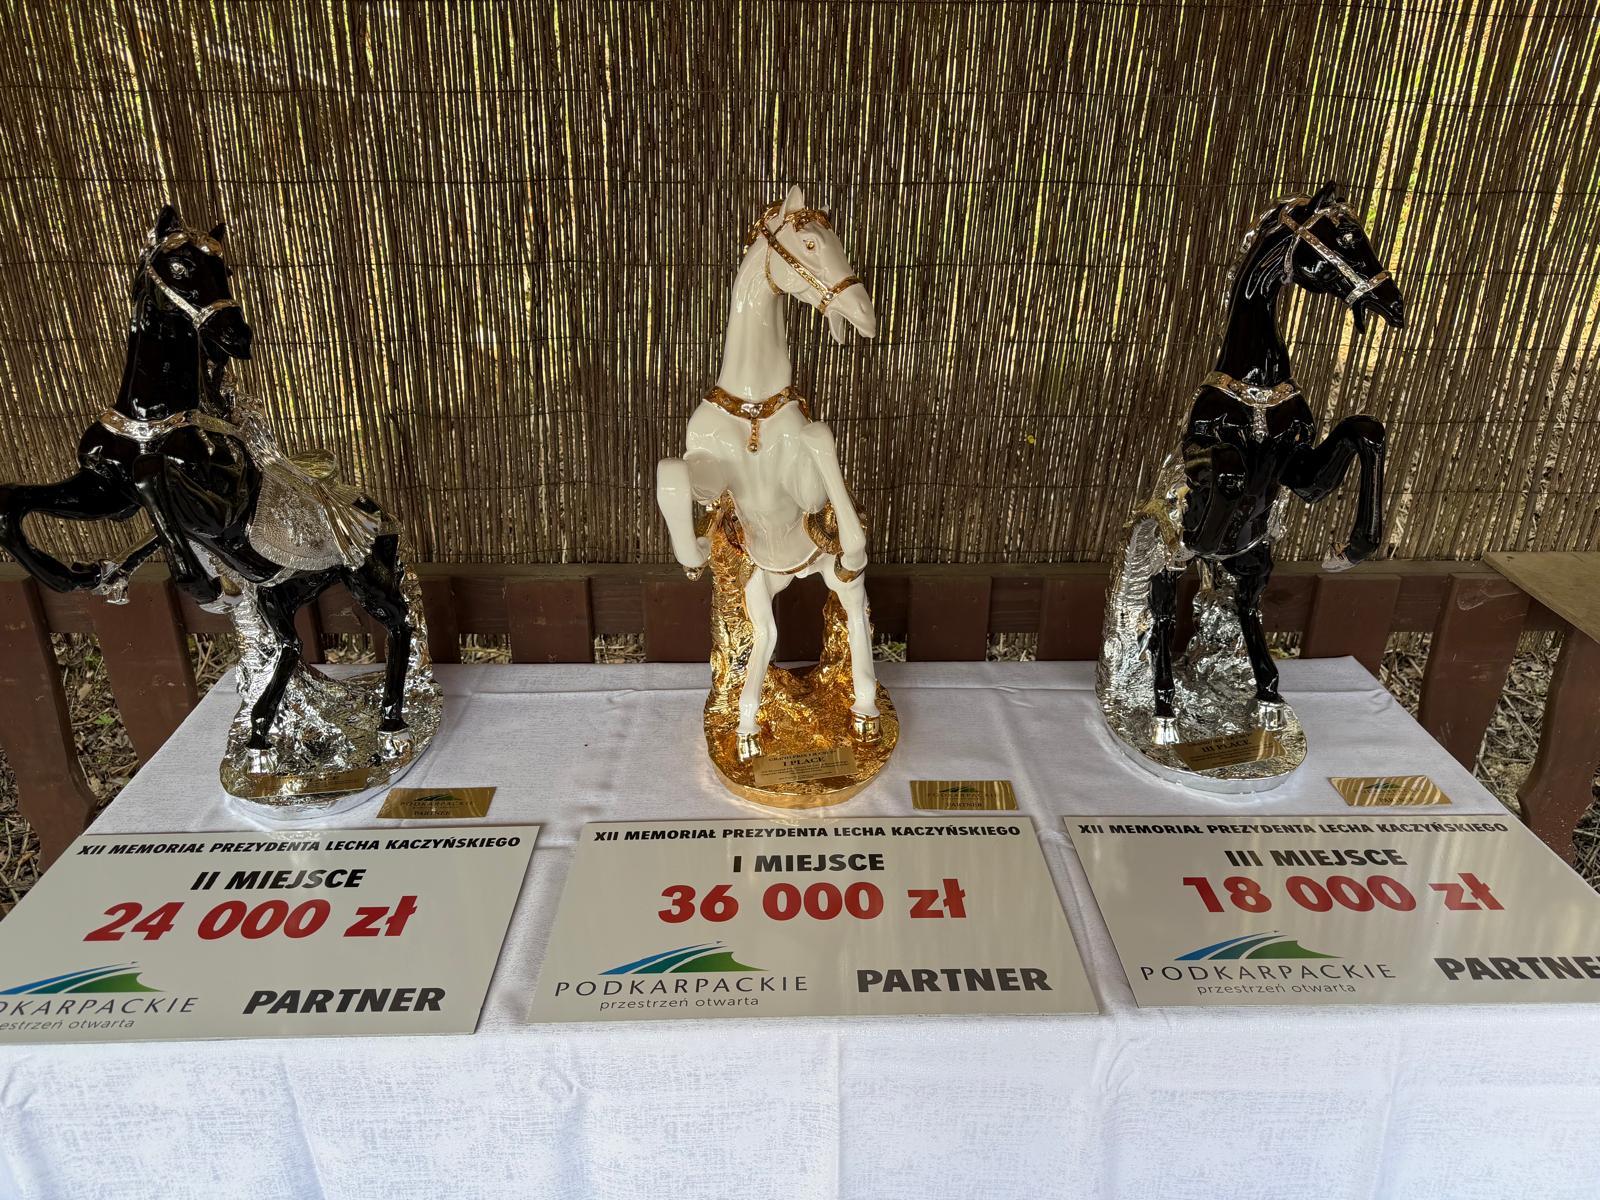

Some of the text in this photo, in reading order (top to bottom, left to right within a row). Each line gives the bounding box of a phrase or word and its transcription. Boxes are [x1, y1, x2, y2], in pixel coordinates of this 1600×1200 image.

[593, 824, 1021, 842] XII MEMORIAŁ PREZYDENTA LECHA KACZYŃSKIEGO
[1077, 820, 1509, 834] XII MEMORIAŁ PREZYDENTA LECHA KACZYŃSKIEGO
[76, 836, 521, 856] XII MEMORIAŁ PREZYDENTA LECHA KACZYŃSKIEGO
[732, 853, 885, 873] I MIEJSCE
[1223, 848, 1408, 867] III MIEJSCE
[190, 868, 367, 891] II MIEJSCE
[657, 878, 967, 924] 36 000 zł
[1182, 872, 1505, 914] 18 000 zł
[82, 895, 418, 942] 24 000 zł
[1139, 964, 1396, 981] PODKARPACKIE
[1433, 955, 1600, 981] PARTNE
[554, 975, 808, 997] PODKARPACKIE
[856, 967, 1054, 993] PARTNER
[1196, 983, 1356, 996] przestrzeń otwarta
[242, 987, 446, 1015] PARTNER
[599, 996, 759, 1012] przestrzeń otwarta
[68, 1018, 136, 1030] otwarta
